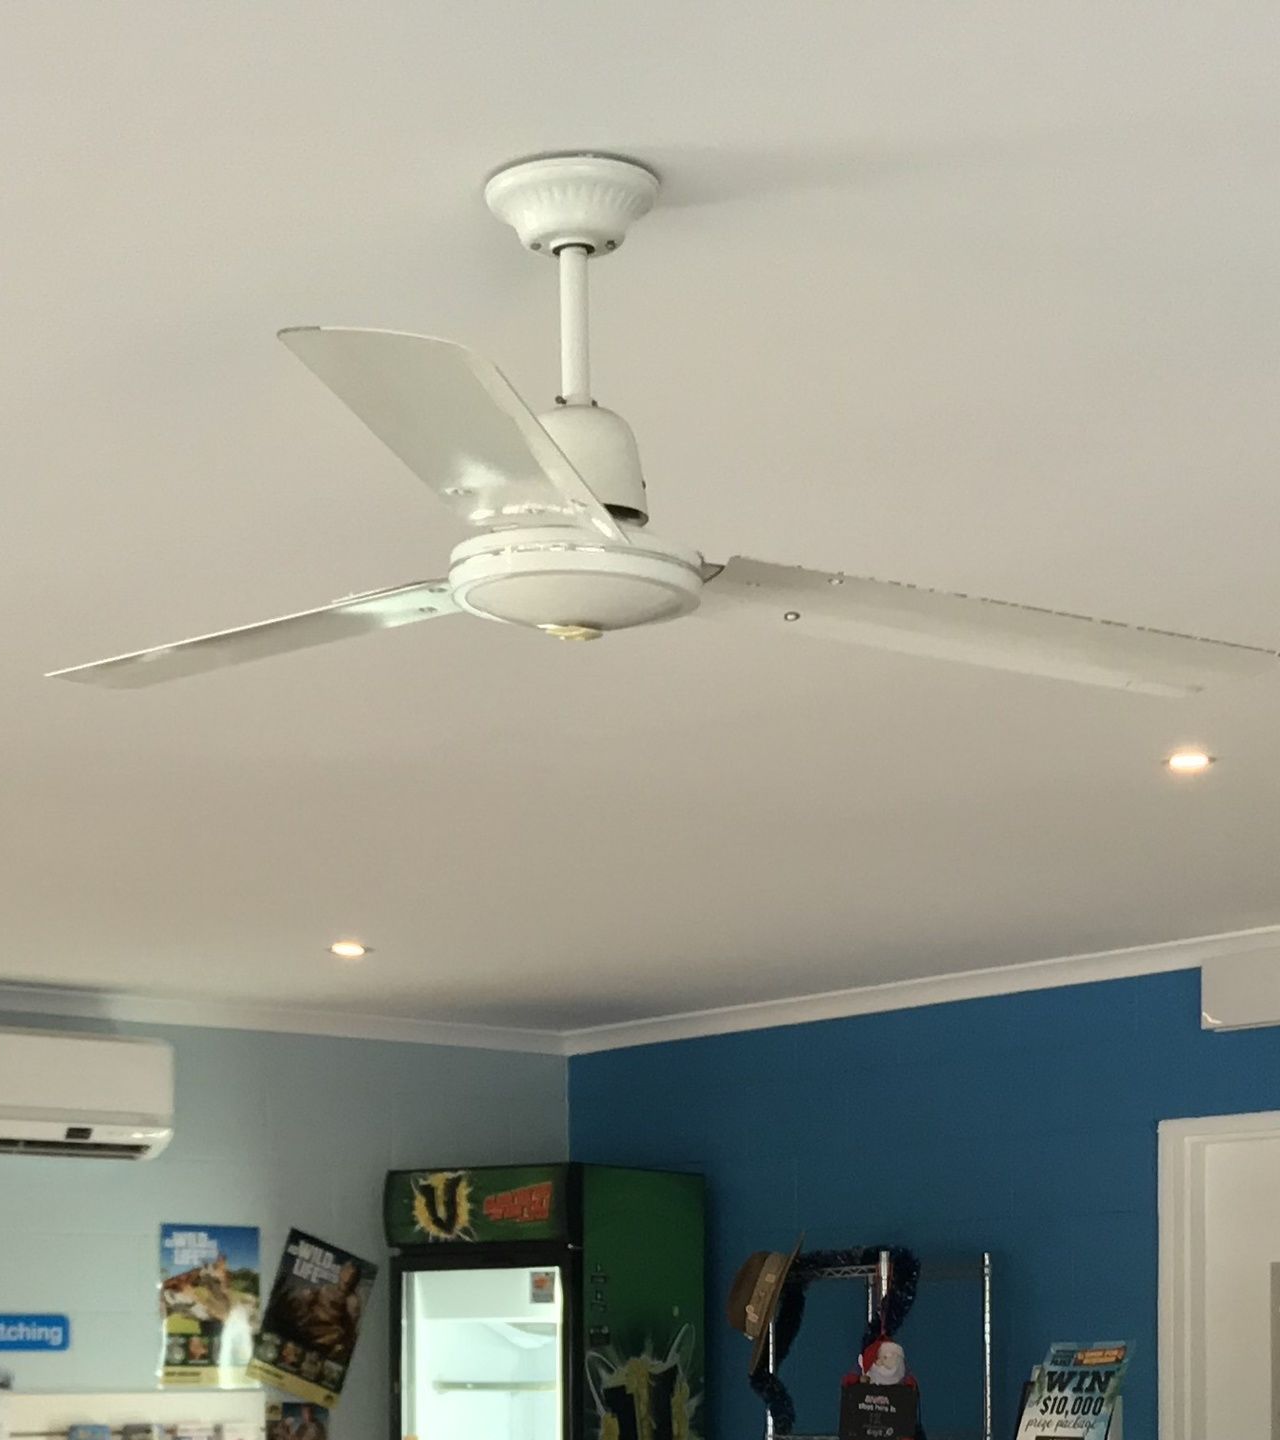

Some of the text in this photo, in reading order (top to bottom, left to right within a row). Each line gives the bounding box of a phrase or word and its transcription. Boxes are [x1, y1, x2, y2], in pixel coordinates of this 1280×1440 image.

[1045, 1370, 1116, 1394] WIN
[1039, 1395, 1105, 1418] $10,000
[1024, 1414, 1097, 1436] prize package
